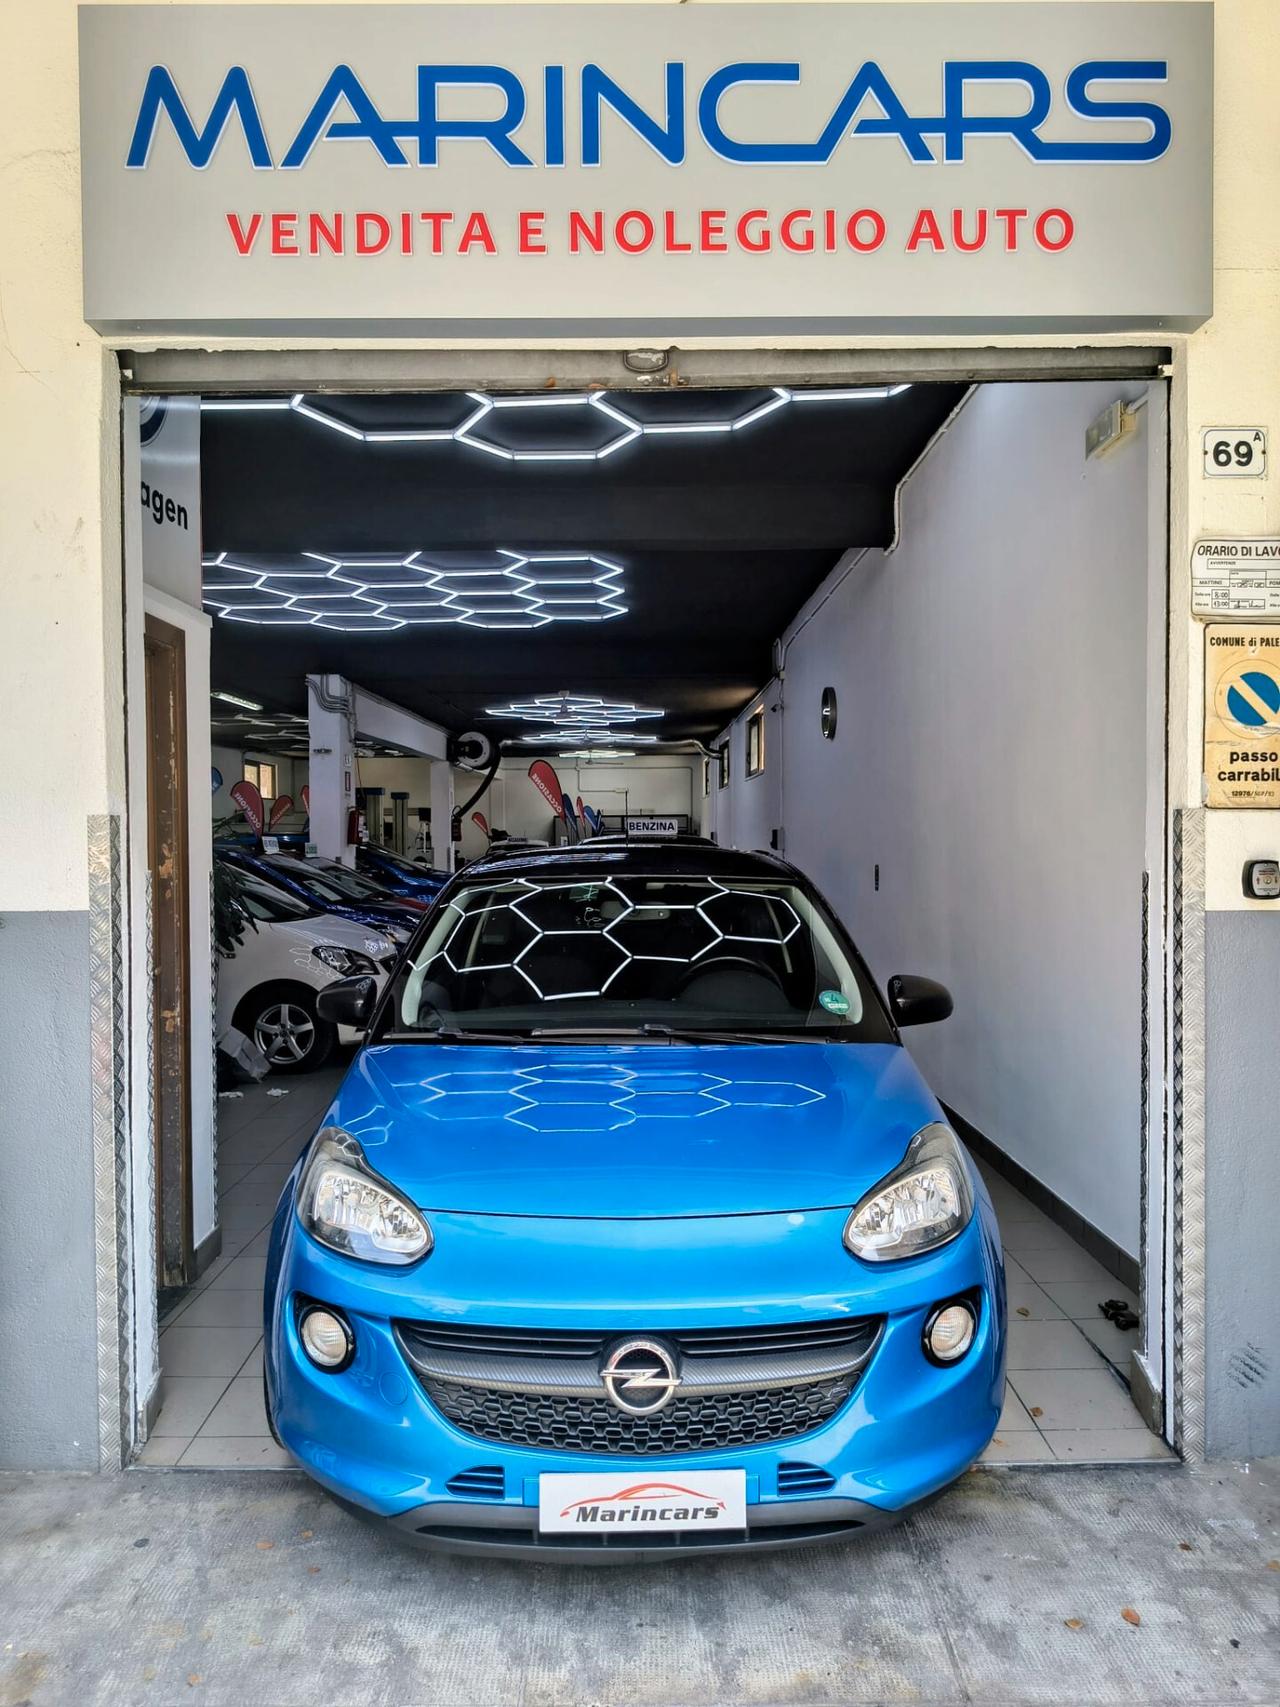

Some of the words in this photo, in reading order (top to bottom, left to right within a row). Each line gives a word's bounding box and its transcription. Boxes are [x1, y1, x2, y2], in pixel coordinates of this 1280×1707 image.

[125, 61, 1172, 169] MARINCARS
[226, 212, 496, 256] VENDITA
[518, 211, 548, 254] E
[569, 209, 886, 254] NOLEGGIO
[906, 208, 1075, 253] AUTO
[1213, 440, 1253, 467] 69
[1253, 431, 1262, 442] A
[1197, 545, 1238, 556] ORARIO
[1241, 546, 1252, 557] DI
[1210, 637, 1245, 647] COMUNE
[1248, 637, 1257, 647] di
[1260, 637, 1280, 647] PALE
[1229, 751, 1278, 764] passo
[1217, 769, 1280, 782] carrabil
[628, 821, 675, 831] BENZINA
[576, 1505, 720, 1523] Marincars
